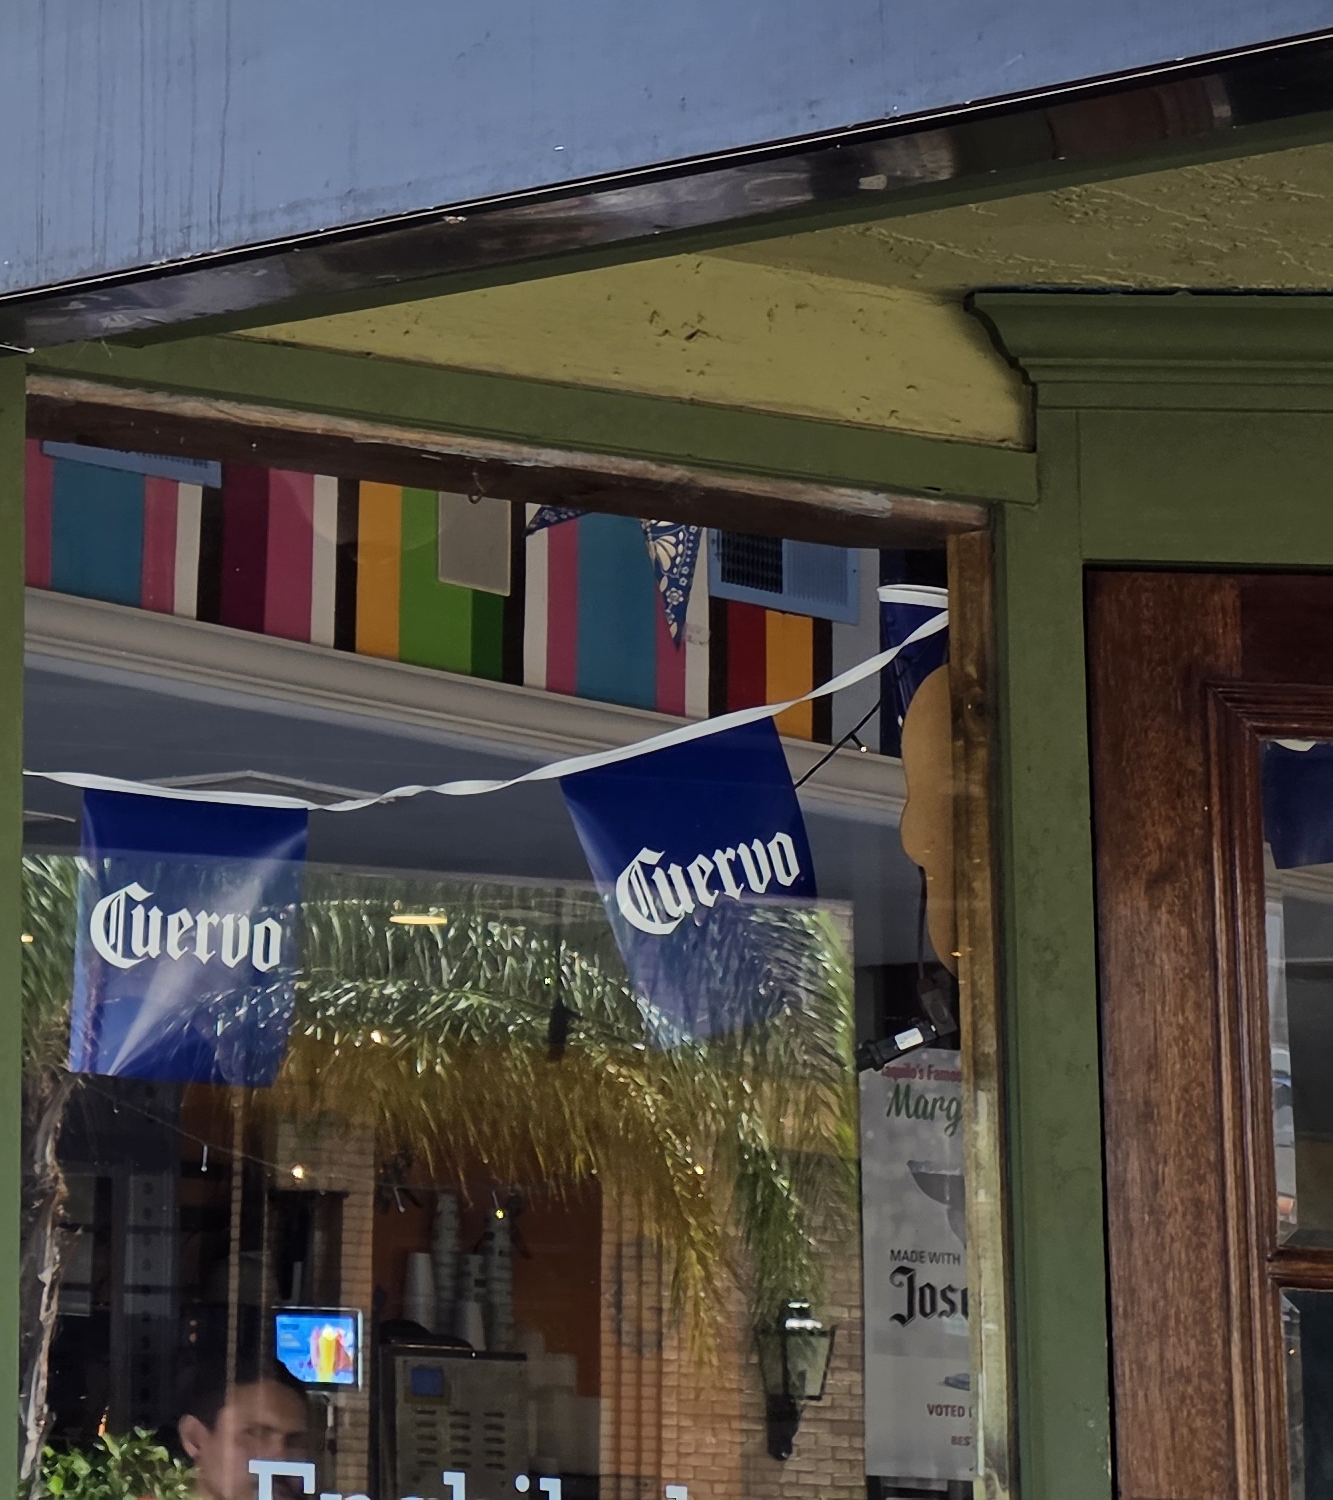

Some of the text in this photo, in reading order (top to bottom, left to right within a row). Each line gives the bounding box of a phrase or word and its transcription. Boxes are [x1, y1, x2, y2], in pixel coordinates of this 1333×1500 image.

[615, 831, 801, 935] Cuervo
[90, 882, 282, 973] Cuervo
[886, 1083, 963, 1137] Marg
[890, 1249, 961, 1266] MADE WITH
[927, 1403, 965, 1418] VOTED
[951, 1435, 973, 1447] BES
